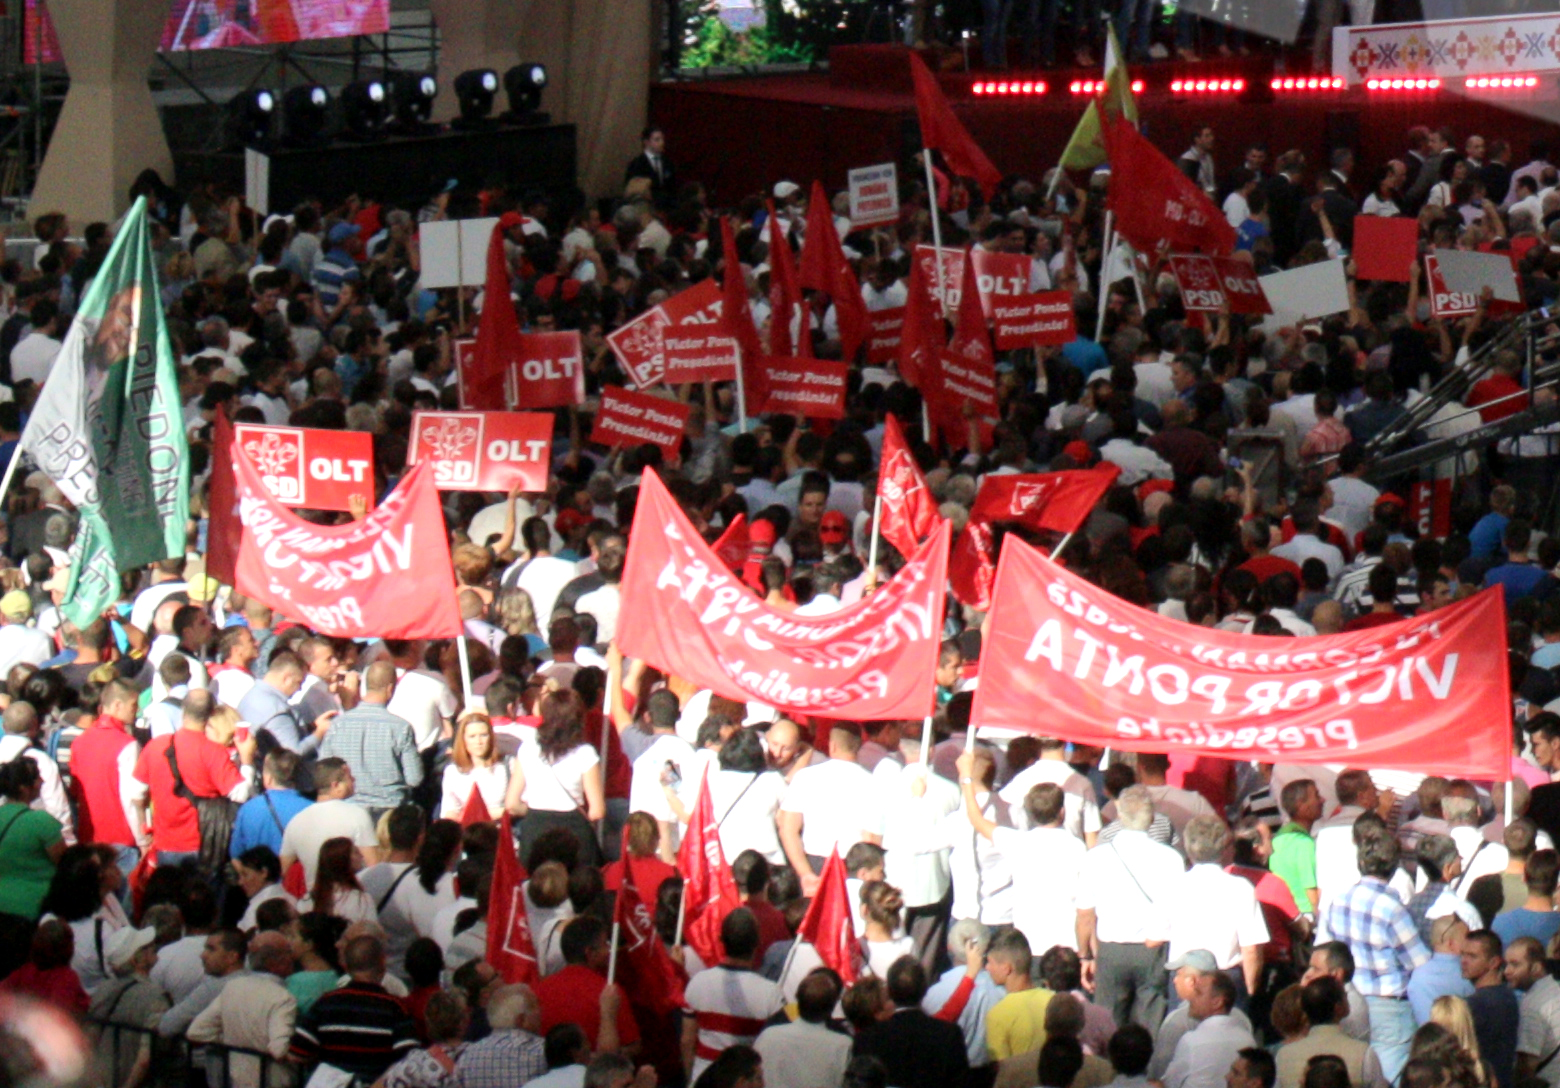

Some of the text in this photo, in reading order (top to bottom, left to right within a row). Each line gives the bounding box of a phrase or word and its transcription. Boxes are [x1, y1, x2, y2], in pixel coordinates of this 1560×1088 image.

[1225, 275, 1259, 295] OLT
[1184, 289, 1224, 306] PSD
[1435, 291, 1476, 310] PSD
[995, 302, 1070, 319] Victor Ponta
[665, 337, 704, 350] Victor
[522, 356, 577, 381] OLT
[802, 371, 844, 386] Ponta
[603, 396, 683, 429] Victor Ponta
[488, 439, 547, 462] OLT
[310, 457, 369, 482] OLT
[433, 460, 472, 483] SD
[263, 475, 298, 498] SD
